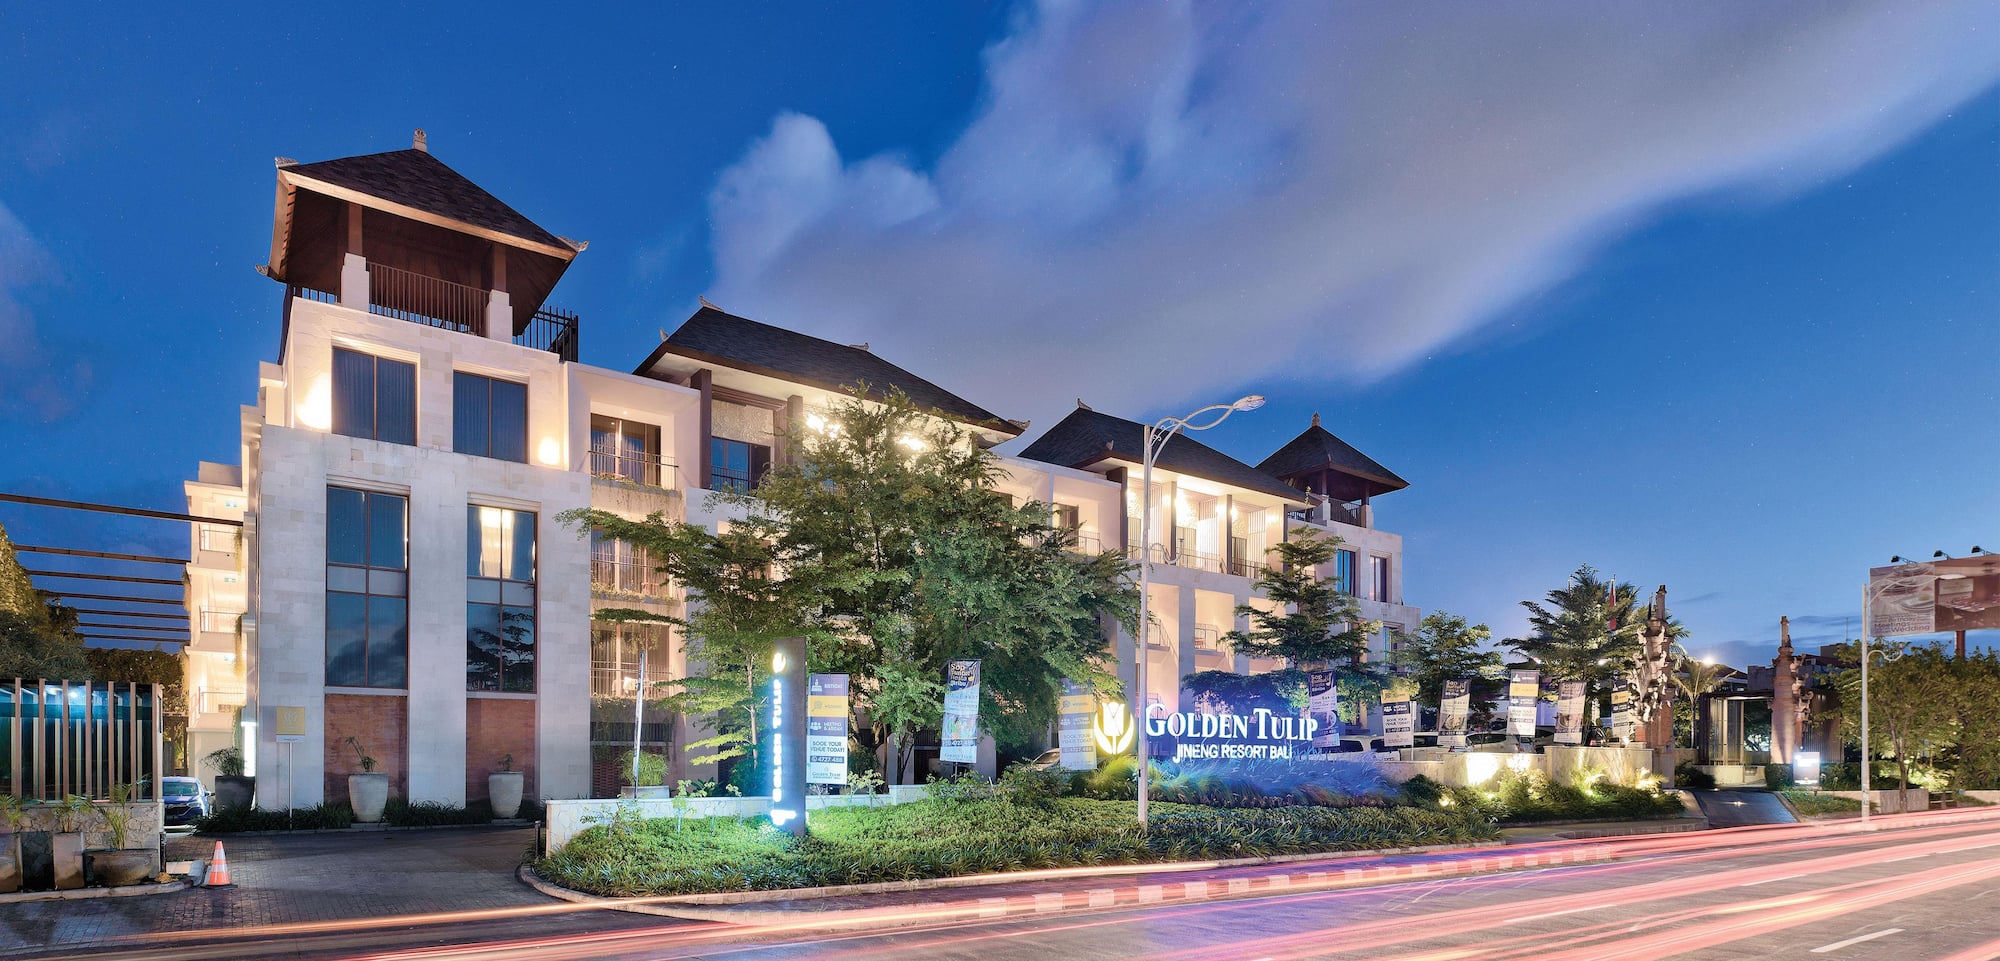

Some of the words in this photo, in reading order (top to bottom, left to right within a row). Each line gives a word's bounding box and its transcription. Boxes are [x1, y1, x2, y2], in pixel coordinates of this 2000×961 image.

[1891, 625, 1930, 633] Wedding
[1146, 703, 1248, 738] GOLDEN
[1253, 708, 1318, 741] TULIP
[1172, 743, 1219, 763] JINENG
[1221, 744, 1268, 760] RESORT
[1269, 745, 1293, 760] BALI
